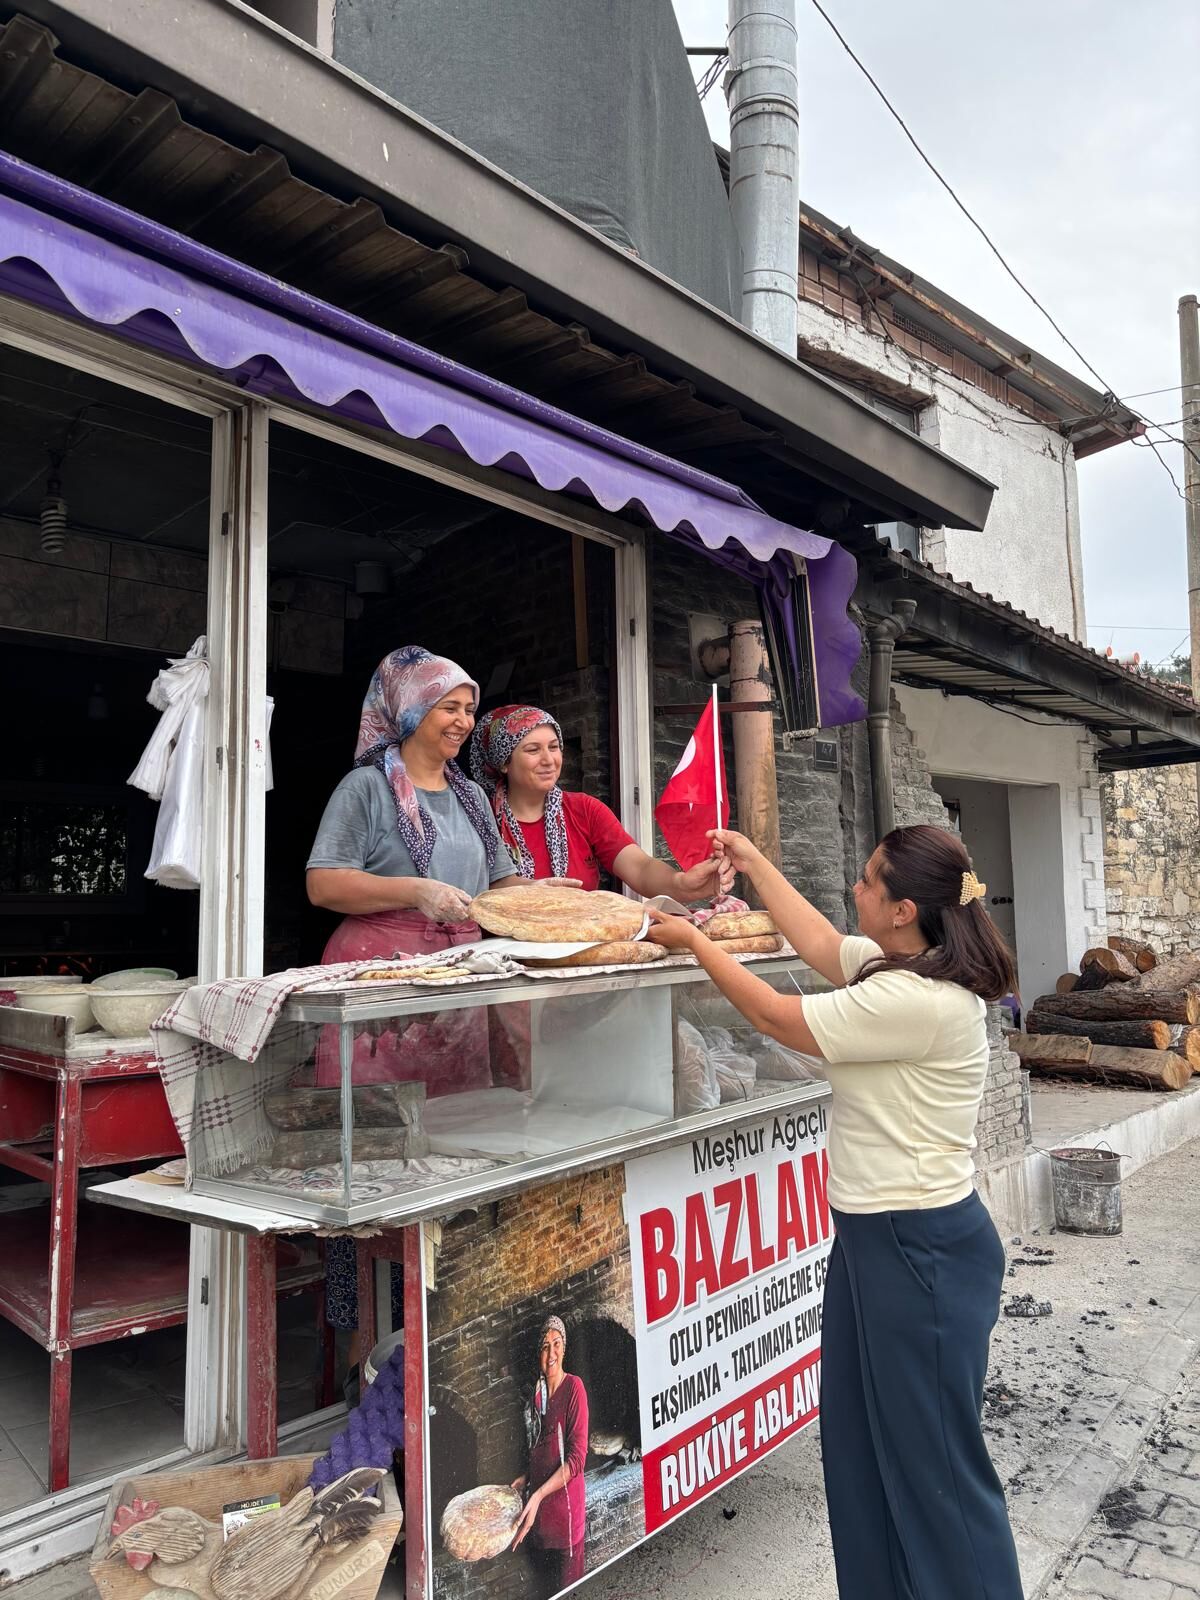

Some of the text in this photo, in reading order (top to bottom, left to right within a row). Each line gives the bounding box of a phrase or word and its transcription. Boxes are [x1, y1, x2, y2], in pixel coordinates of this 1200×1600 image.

[692, 1104, 827, 1174] Meşhur Ağaçlı
[669, 1320, 703, 1367] OTLU
[706, 1285, 761, 1347] PEYNİRLİ
[762, 1267, 813, 1316] GÖZLEME
[651, 1362, 722, 1431] EKŞİMAYA
[724, 1371, 729, 1379] -
[731, 1320, 794, 1382] TATLIMAYA
[659, 1408, 748, 1512] RUKİYE
